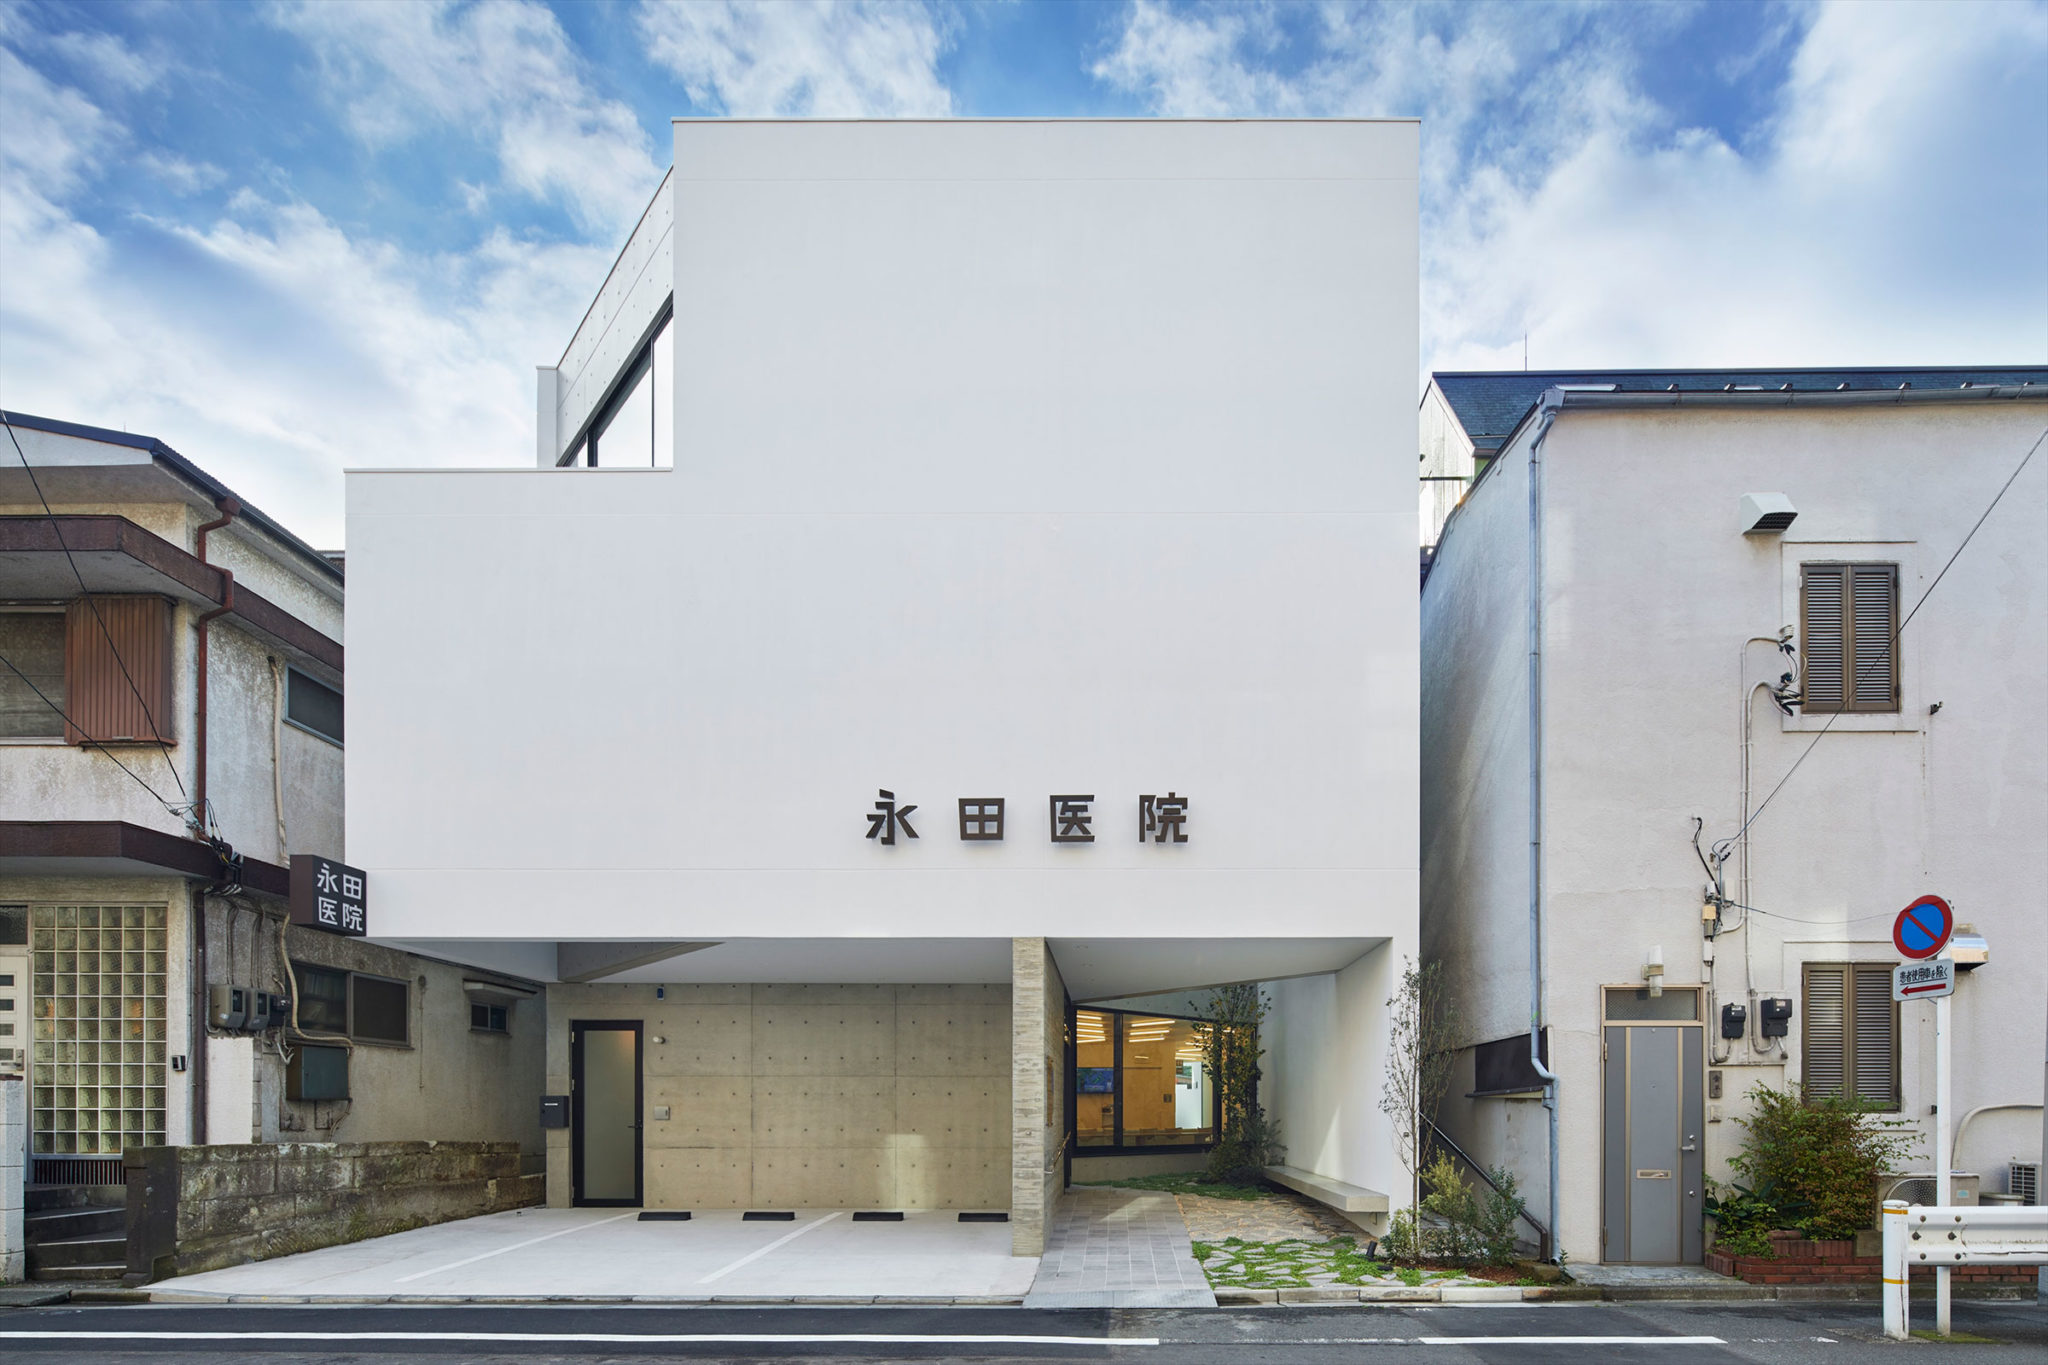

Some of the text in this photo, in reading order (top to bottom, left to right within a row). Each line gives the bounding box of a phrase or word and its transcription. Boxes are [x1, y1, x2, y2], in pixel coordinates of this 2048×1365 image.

[865, 788, 1188, 845] 永田医院
[317, 862, 362, 900] 永田
[318, 896, 363, 932] 医院
